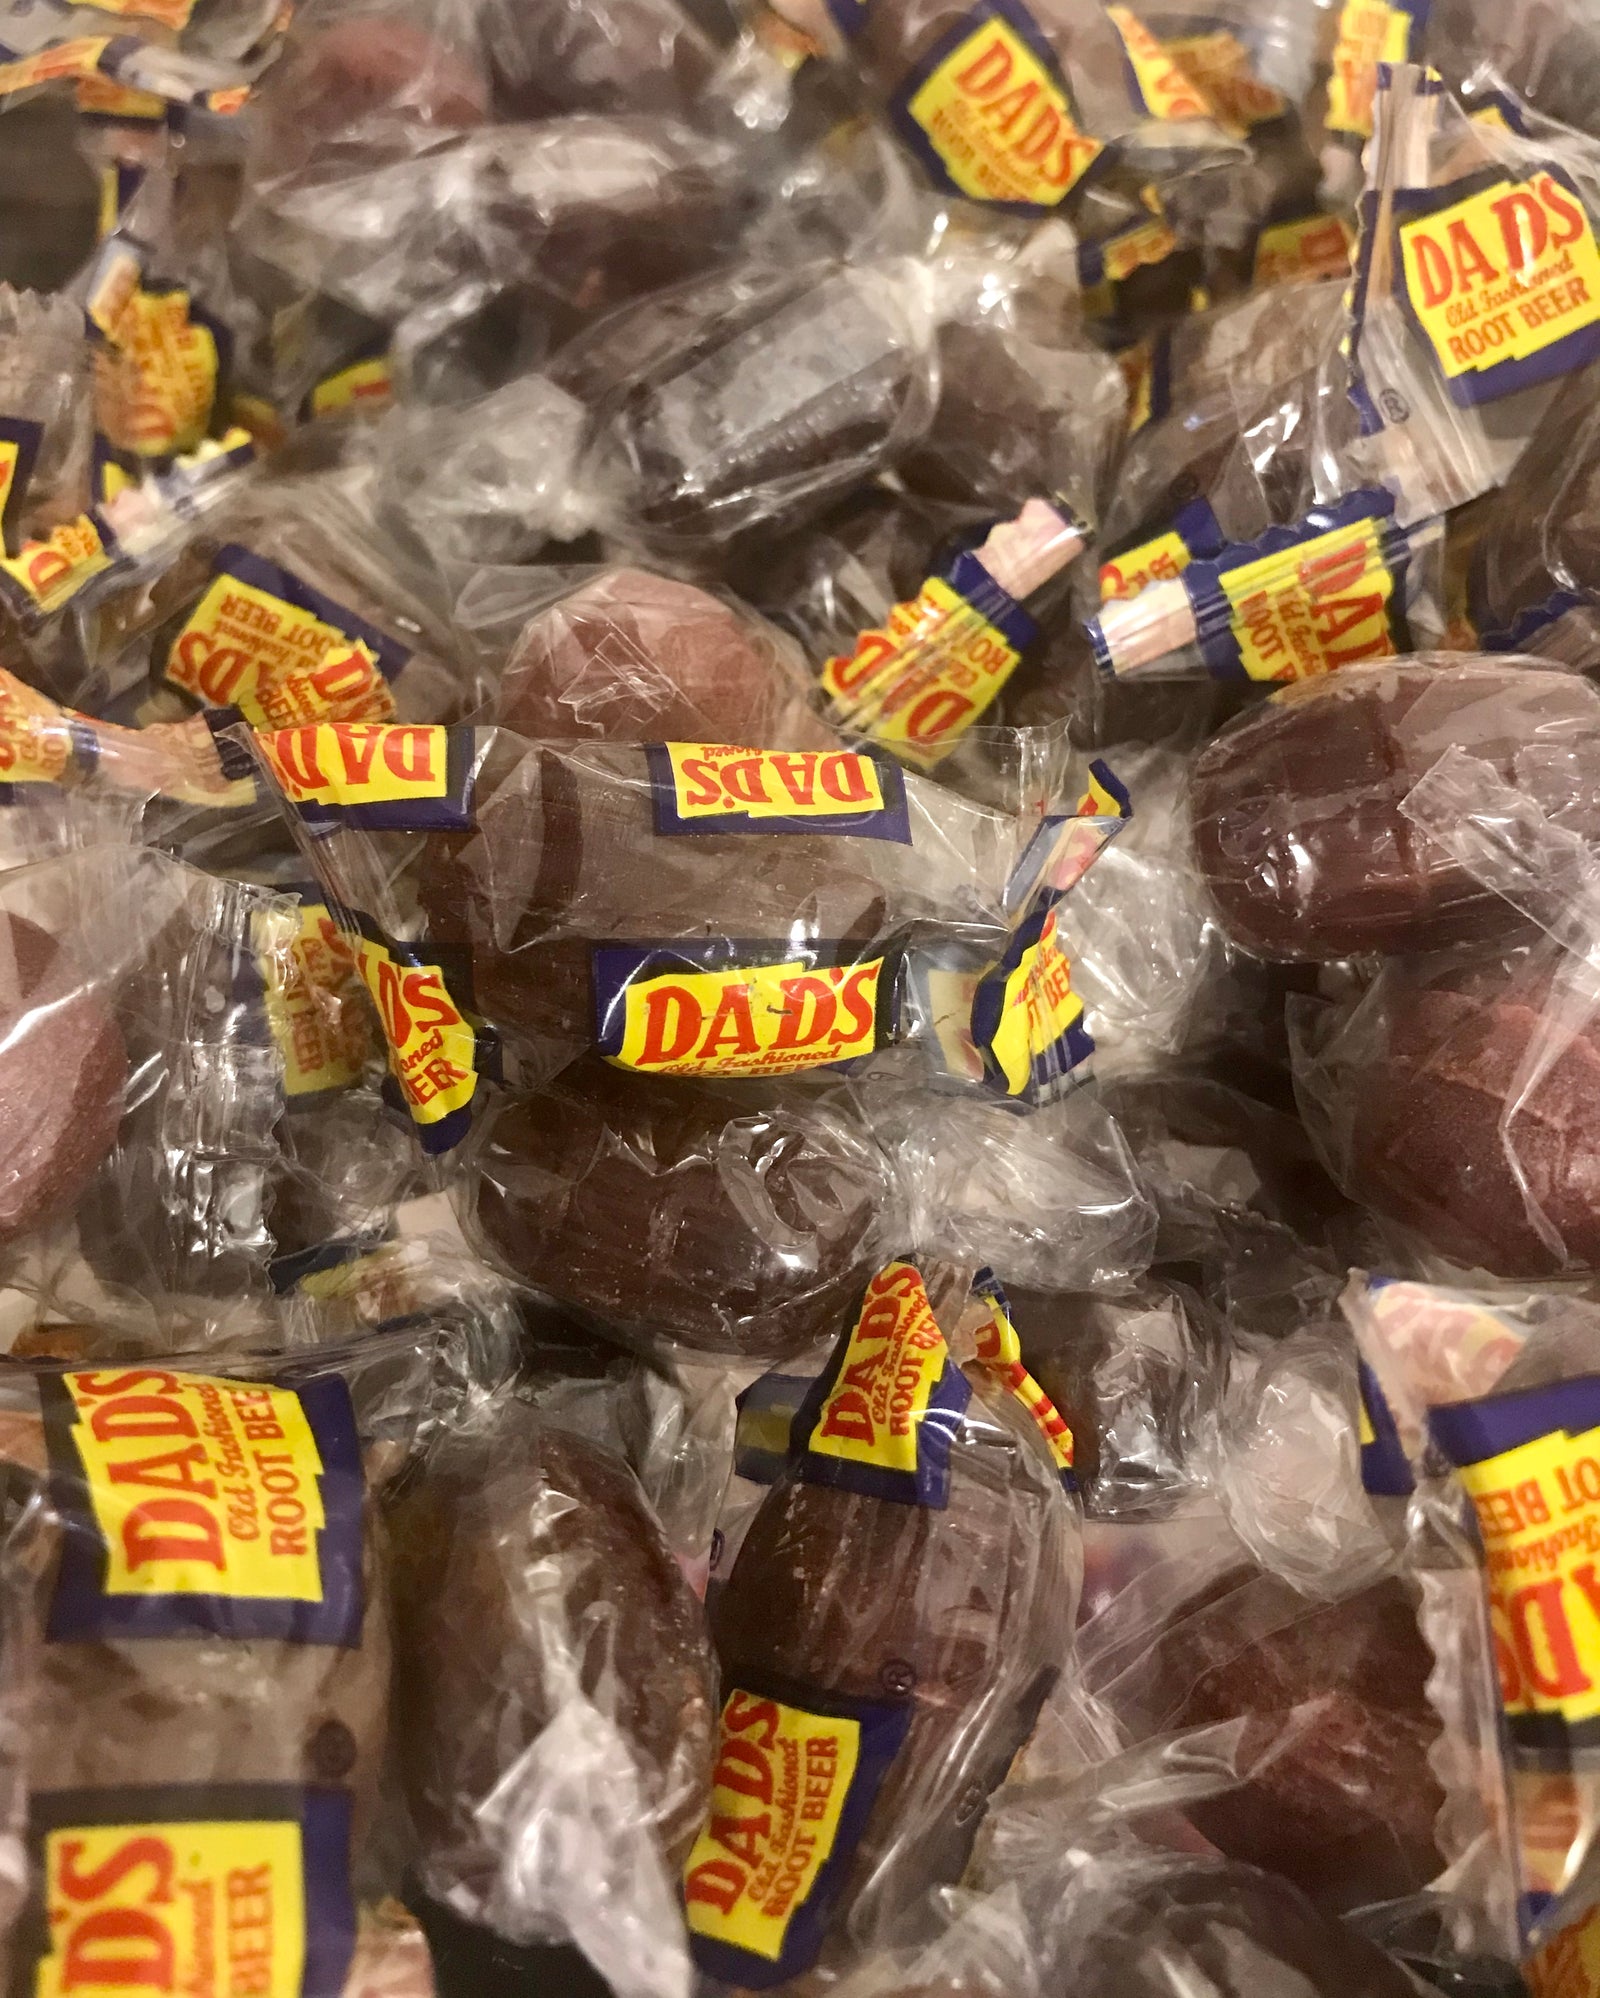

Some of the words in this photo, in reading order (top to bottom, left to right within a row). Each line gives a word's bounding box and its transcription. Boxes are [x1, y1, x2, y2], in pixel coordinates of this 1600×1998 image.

[1446, 312, 1518, 365] ROOT
[1517, 276, 1593, 330] BEER
[219, 592, 284, 635] BEER
[681, 752, 874, 808] DAD'S
[635, 963, 881, 1066] DAD'S
[715, 1044, 840, 1070] Fashioned
[821, 1266, 923, 1448] DAD'S
[889, 1354, 925, 1436] ROOT
[222, 1386, 286, 1441] BEE
[73, 1369, 228, 1574] DAD'S
[223, 1484, 260, 1542] Old
[253, 1450, 308, 1556] ROOT
[761, 1828, 818, 1917] ROOT
[800, 1735, 838, 1821] BEER
